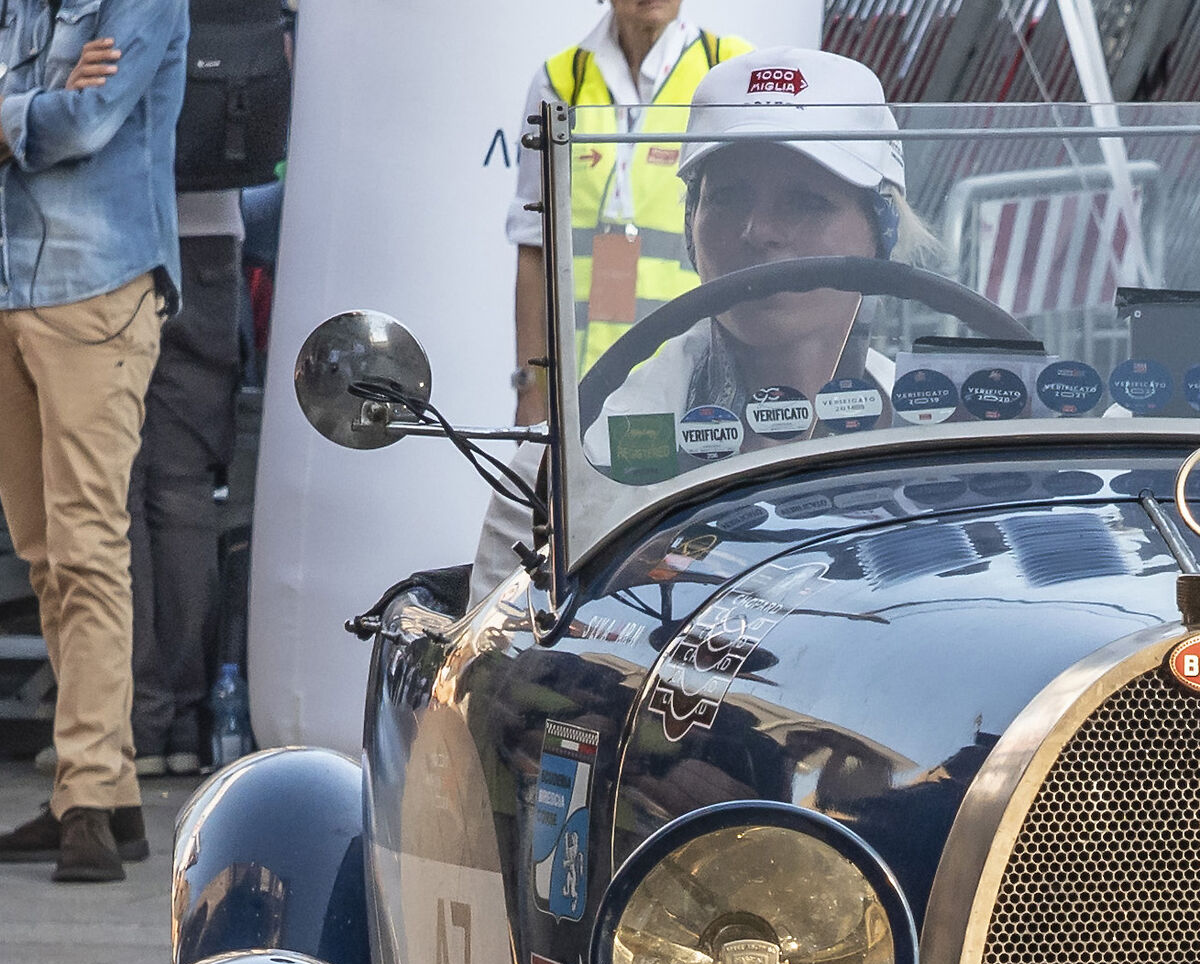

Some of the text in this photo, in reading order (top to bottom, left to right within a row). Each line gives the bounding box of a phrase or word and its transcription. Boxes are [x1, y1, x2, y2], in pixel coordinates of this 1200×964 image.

[755, 70, 795, 81] 1000
[750, 82, 796, 92] MIGLIA
[896, 389, 950, 398] VERIFICATO
[968, 387, 1022, 398] VERIFICATO
[753, 407, 809, 422] VERIFICATO
[682, 427, 739, 443] VERIFICATO
